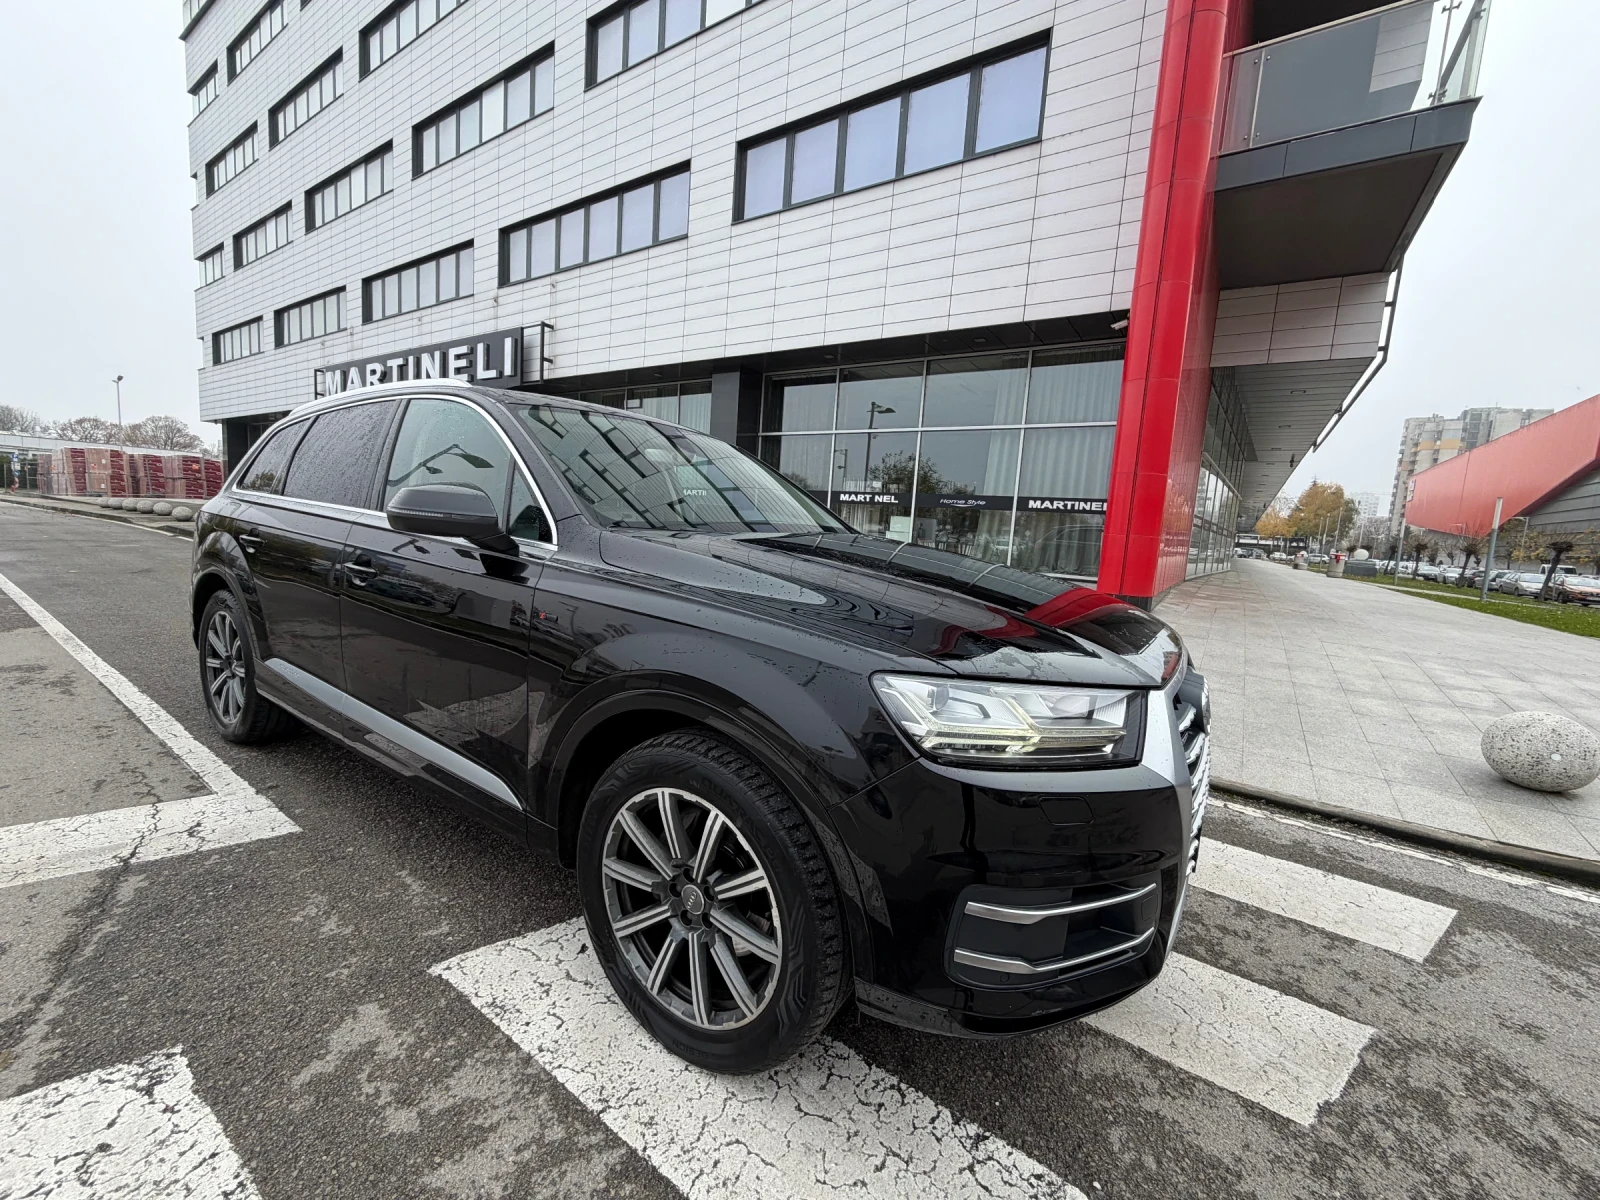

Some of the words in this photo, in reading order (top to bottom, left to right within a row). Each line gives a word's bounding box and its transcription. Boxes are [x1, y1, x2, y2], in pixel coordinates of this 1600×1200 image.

[325, 336, 516, 397] MARTINELI
[840, 494, 872, 502] MART
[874, 495, 899, 503] NEL
